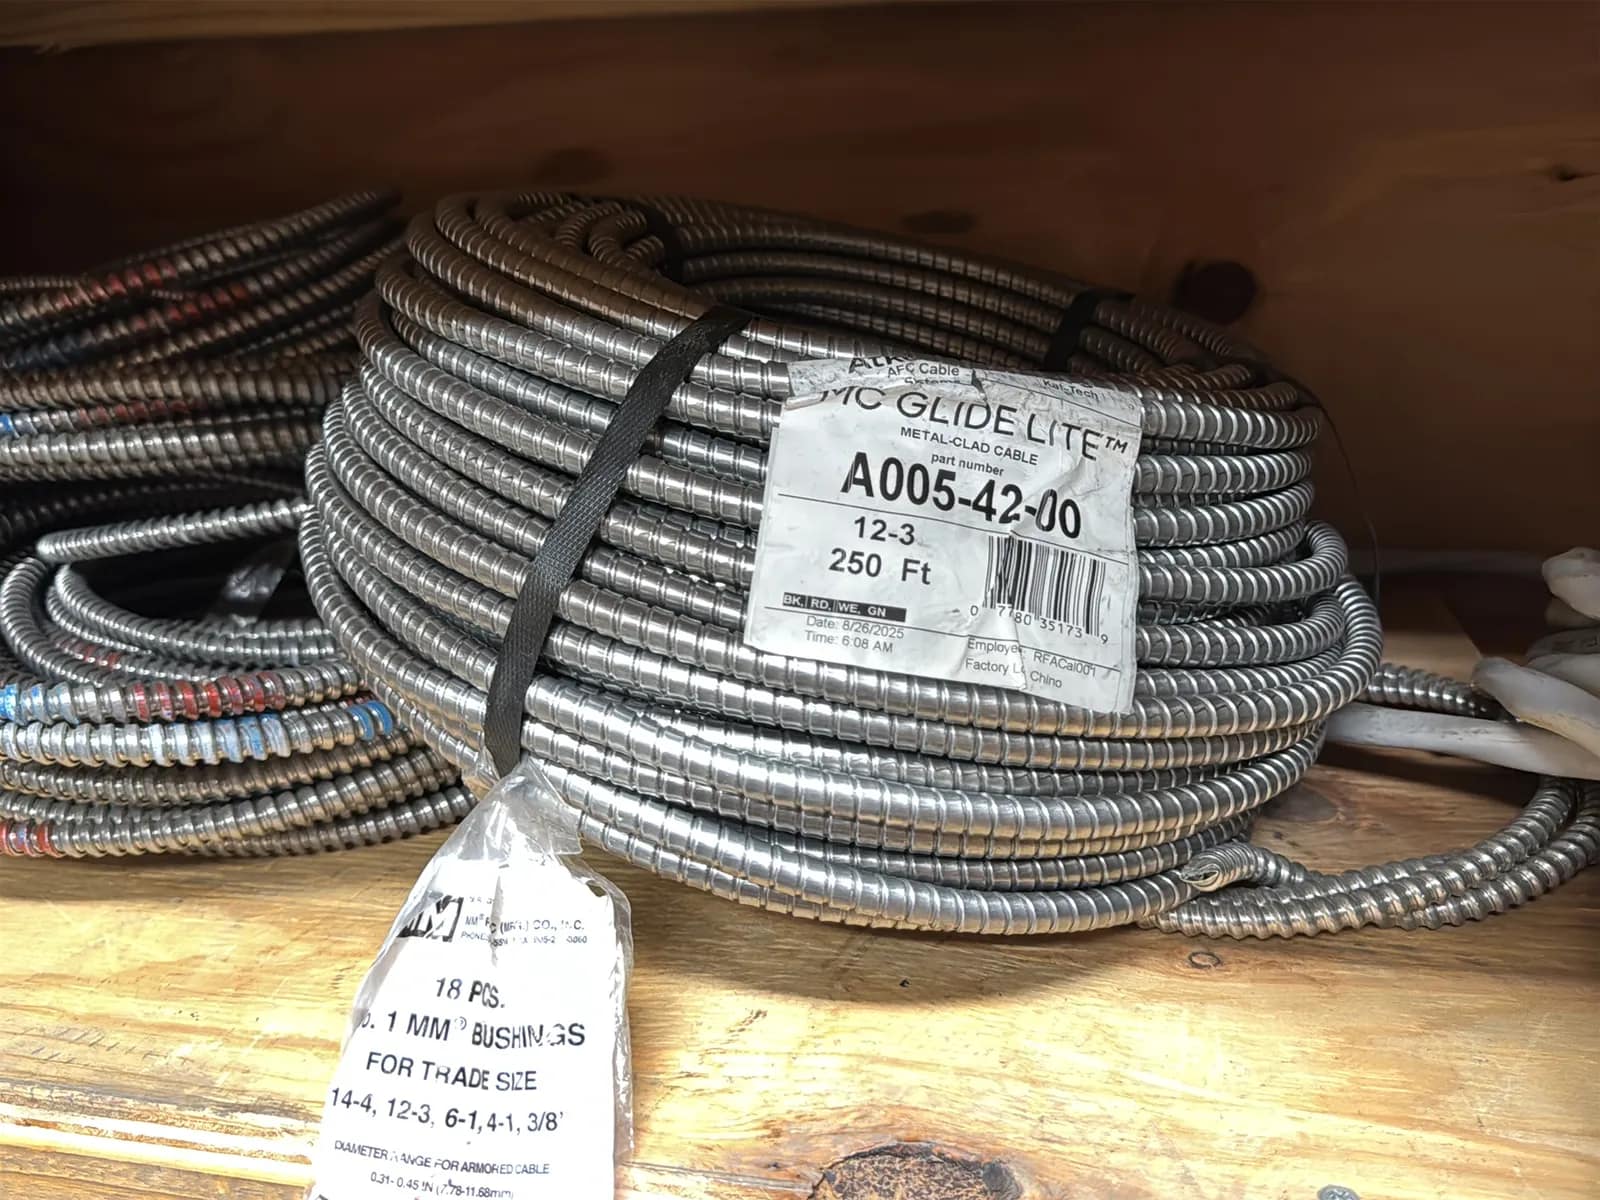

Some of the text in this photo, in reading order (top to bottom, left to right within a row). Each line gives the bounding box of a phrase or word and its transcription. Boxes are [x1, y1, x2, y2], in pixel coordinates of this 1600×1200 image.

[887, 363, 960, 378] AFC Cable
[897, 391, 1017, 436] GLIDE
[900, 426, 1039, 465] METAL-CLAD CABLE
[931, 452, 1004, 476] part number
[841, 451, 1081, 539] A005-42-00
[854, 515, 915, 545] 12-3
[828, 547, 931, 584] 250 Ft
[806, 615, 905, 640] Date: 8/26/2025
[867, 606, 887, 618] GN
[970, 605, 979, 616] 0
[1040, 617, 1082, 639] 35173
[1100, 634, 1108, 644] 9
[805, 630, 893, 653] Time: 6:08 AM
[965, 657, 1009, 676] Factory
[1030, 670, 1062, 688] Chino
[436, 977, 505, 1008] 18 PCS.
[387, 1010, 397, 1032] 1
[472, 1021, 586, 1050] BUSHINGS
[366, 1052, 538, 1091] FOR TRADE SIZE
[331, 1087, 377, 1116] 14-4,
[387, 1098, 435, 1127] 12-3,
[334, 1139, 388, 1161] DIAMETER
[434, 1157, 459, 1172] FOR
[460, 1160, 513, 1175] ARMORED
[514, 1163, 550, 1175] CABLE
[396, 1177, 419, 1191] 0.45
